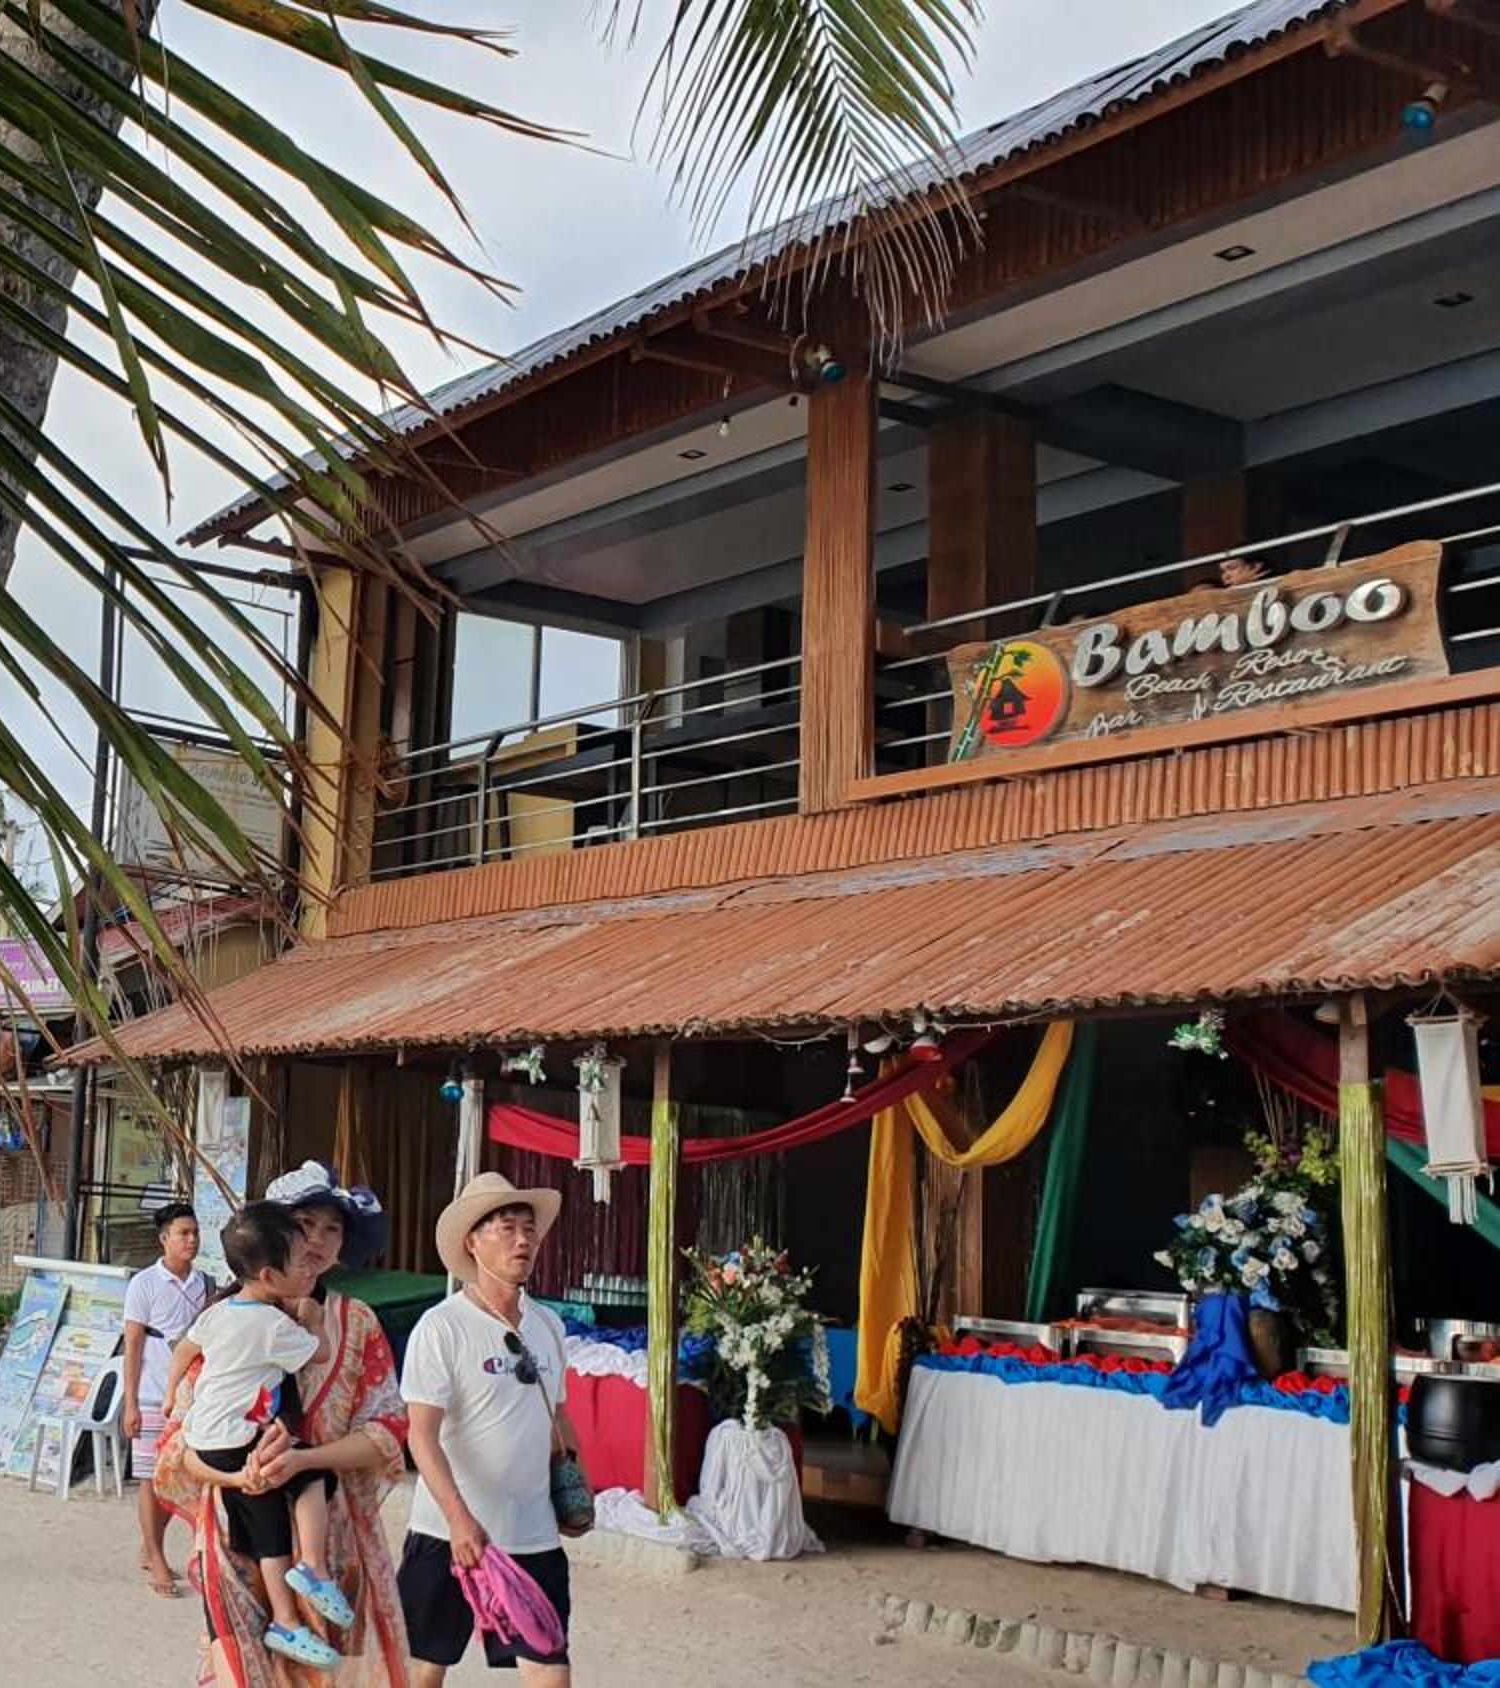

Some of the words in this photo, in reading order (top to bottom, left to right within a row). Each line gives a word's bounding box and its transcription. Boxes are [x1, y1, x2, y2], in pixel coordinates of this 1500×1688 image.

[1073, 578, 1406, 688] Bamboo
[1124, 671, 1213, 701] Beach
[1230, 646, 1347, 680] Resort
[1211, 654, 1409, 712] Restaurant
